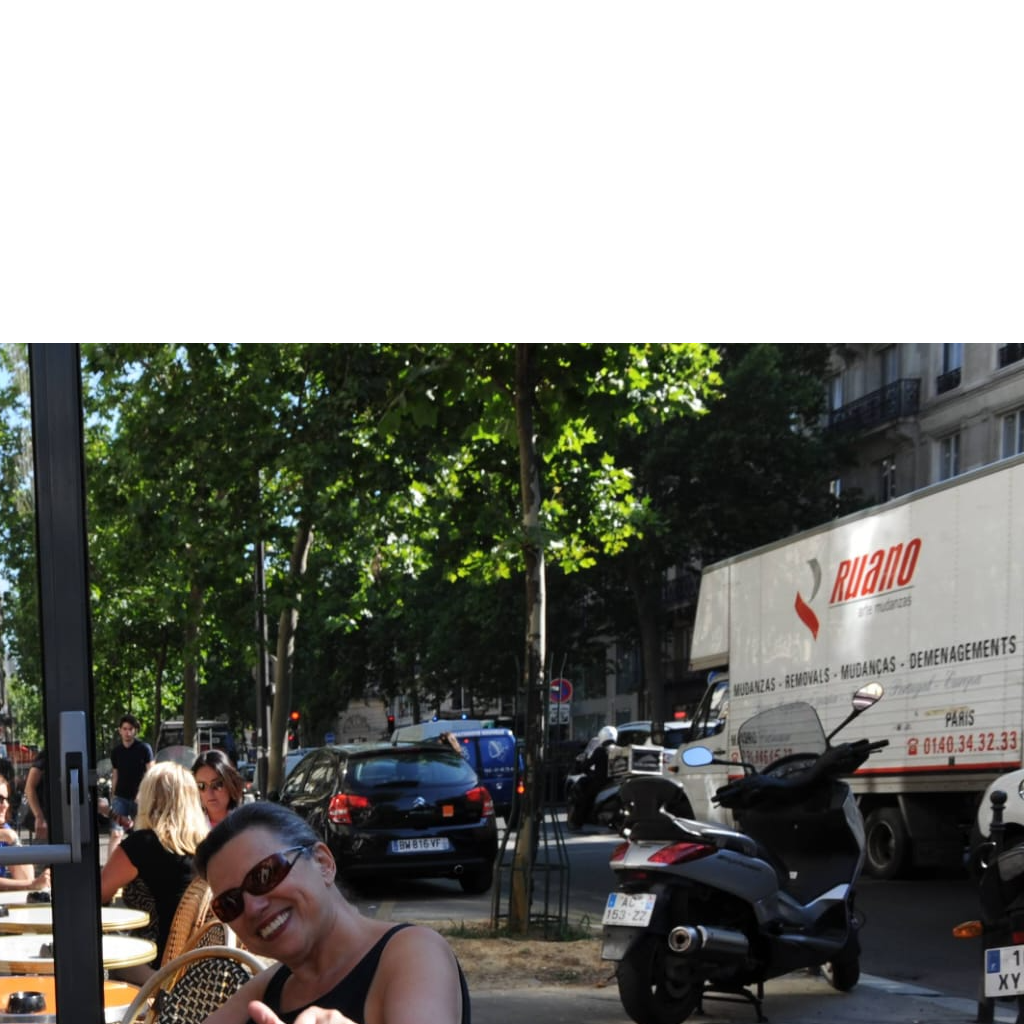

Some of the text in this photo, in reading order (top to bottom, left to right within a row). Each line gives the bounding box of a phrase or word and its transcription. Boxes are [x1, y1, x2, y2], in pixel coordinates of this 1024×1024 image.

[829, 537, 923, 604] Ruano
[734, 677, 776, 697] MUDANZAS
[785, 667, 830, 688] REMOVALS
[909, 635, 1017, 669] DEMENAGEMENTS
[945, 709, 975, 728] PARIS
